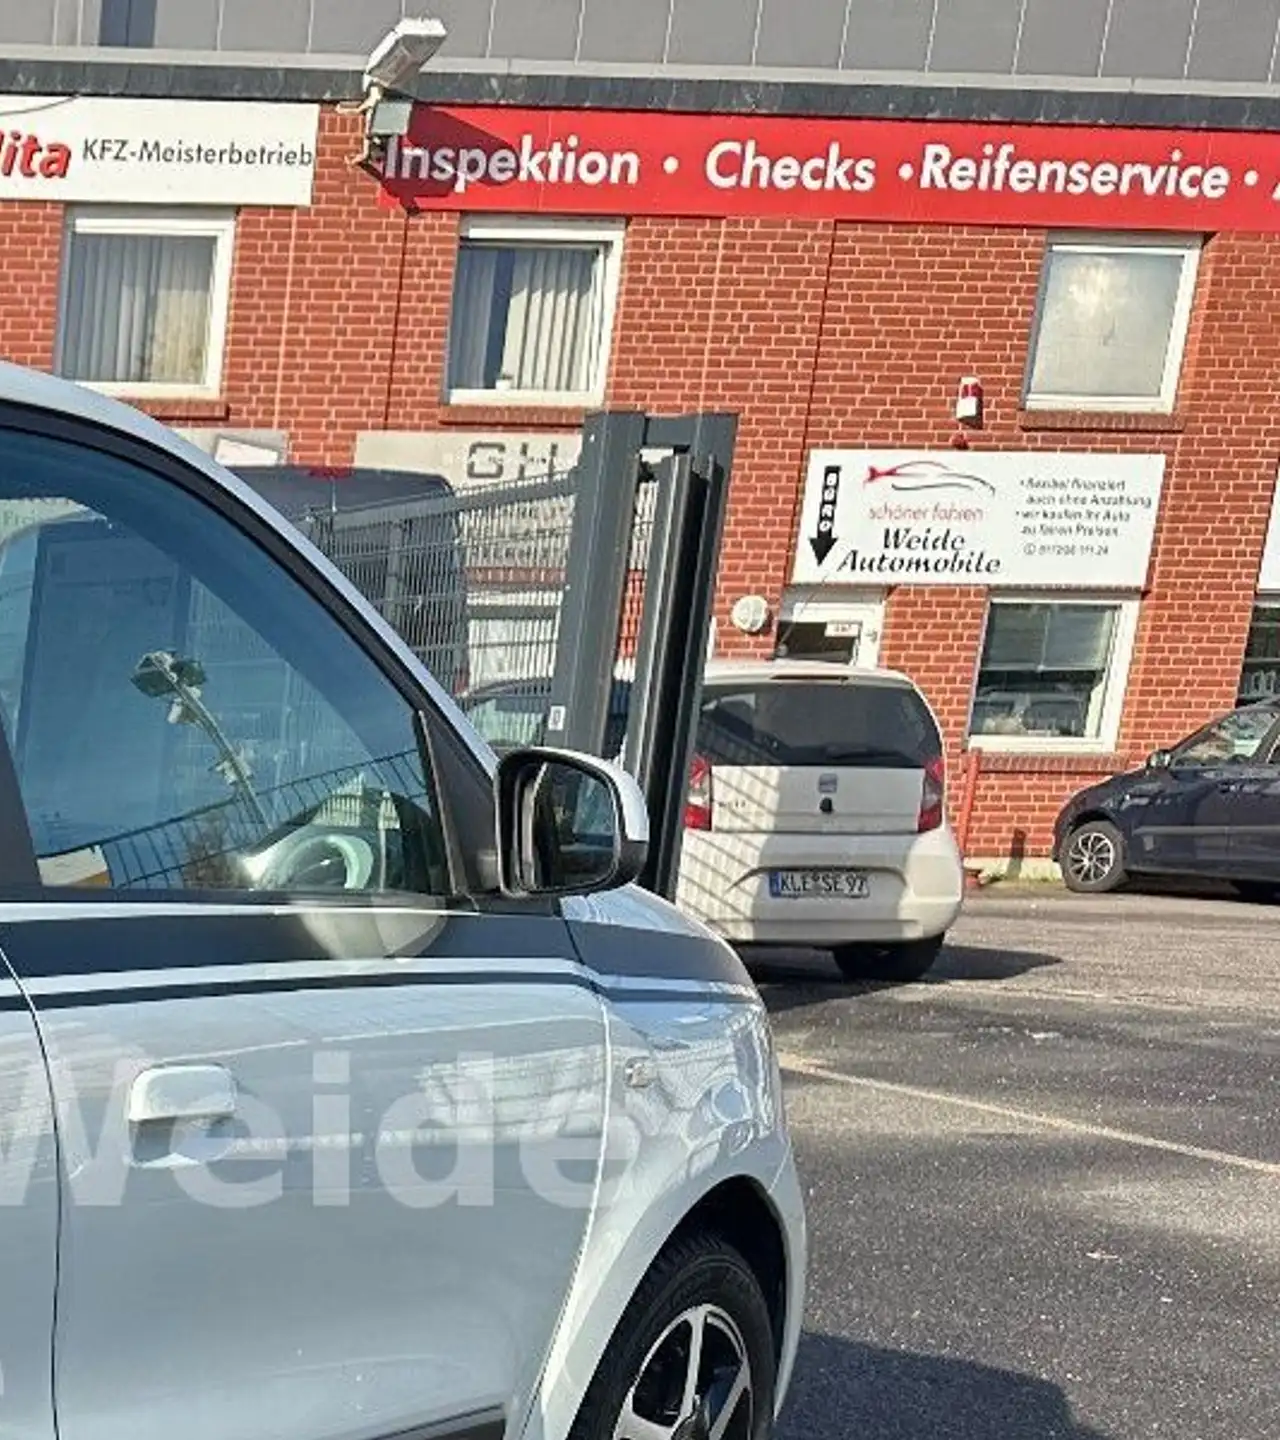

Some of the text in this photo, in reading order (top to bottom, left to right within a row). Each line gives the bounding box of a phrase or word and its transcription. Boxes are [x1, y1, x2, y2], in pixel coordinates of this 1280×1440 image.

[82, 138, 314, 168] KFZ-Meisterbetrieb
[383, 134, 1230, 199] Inspektion Checks Reifenservice
[883, 527, 966, 551] Weide
[836, 549, 1002, 574] Automobile
